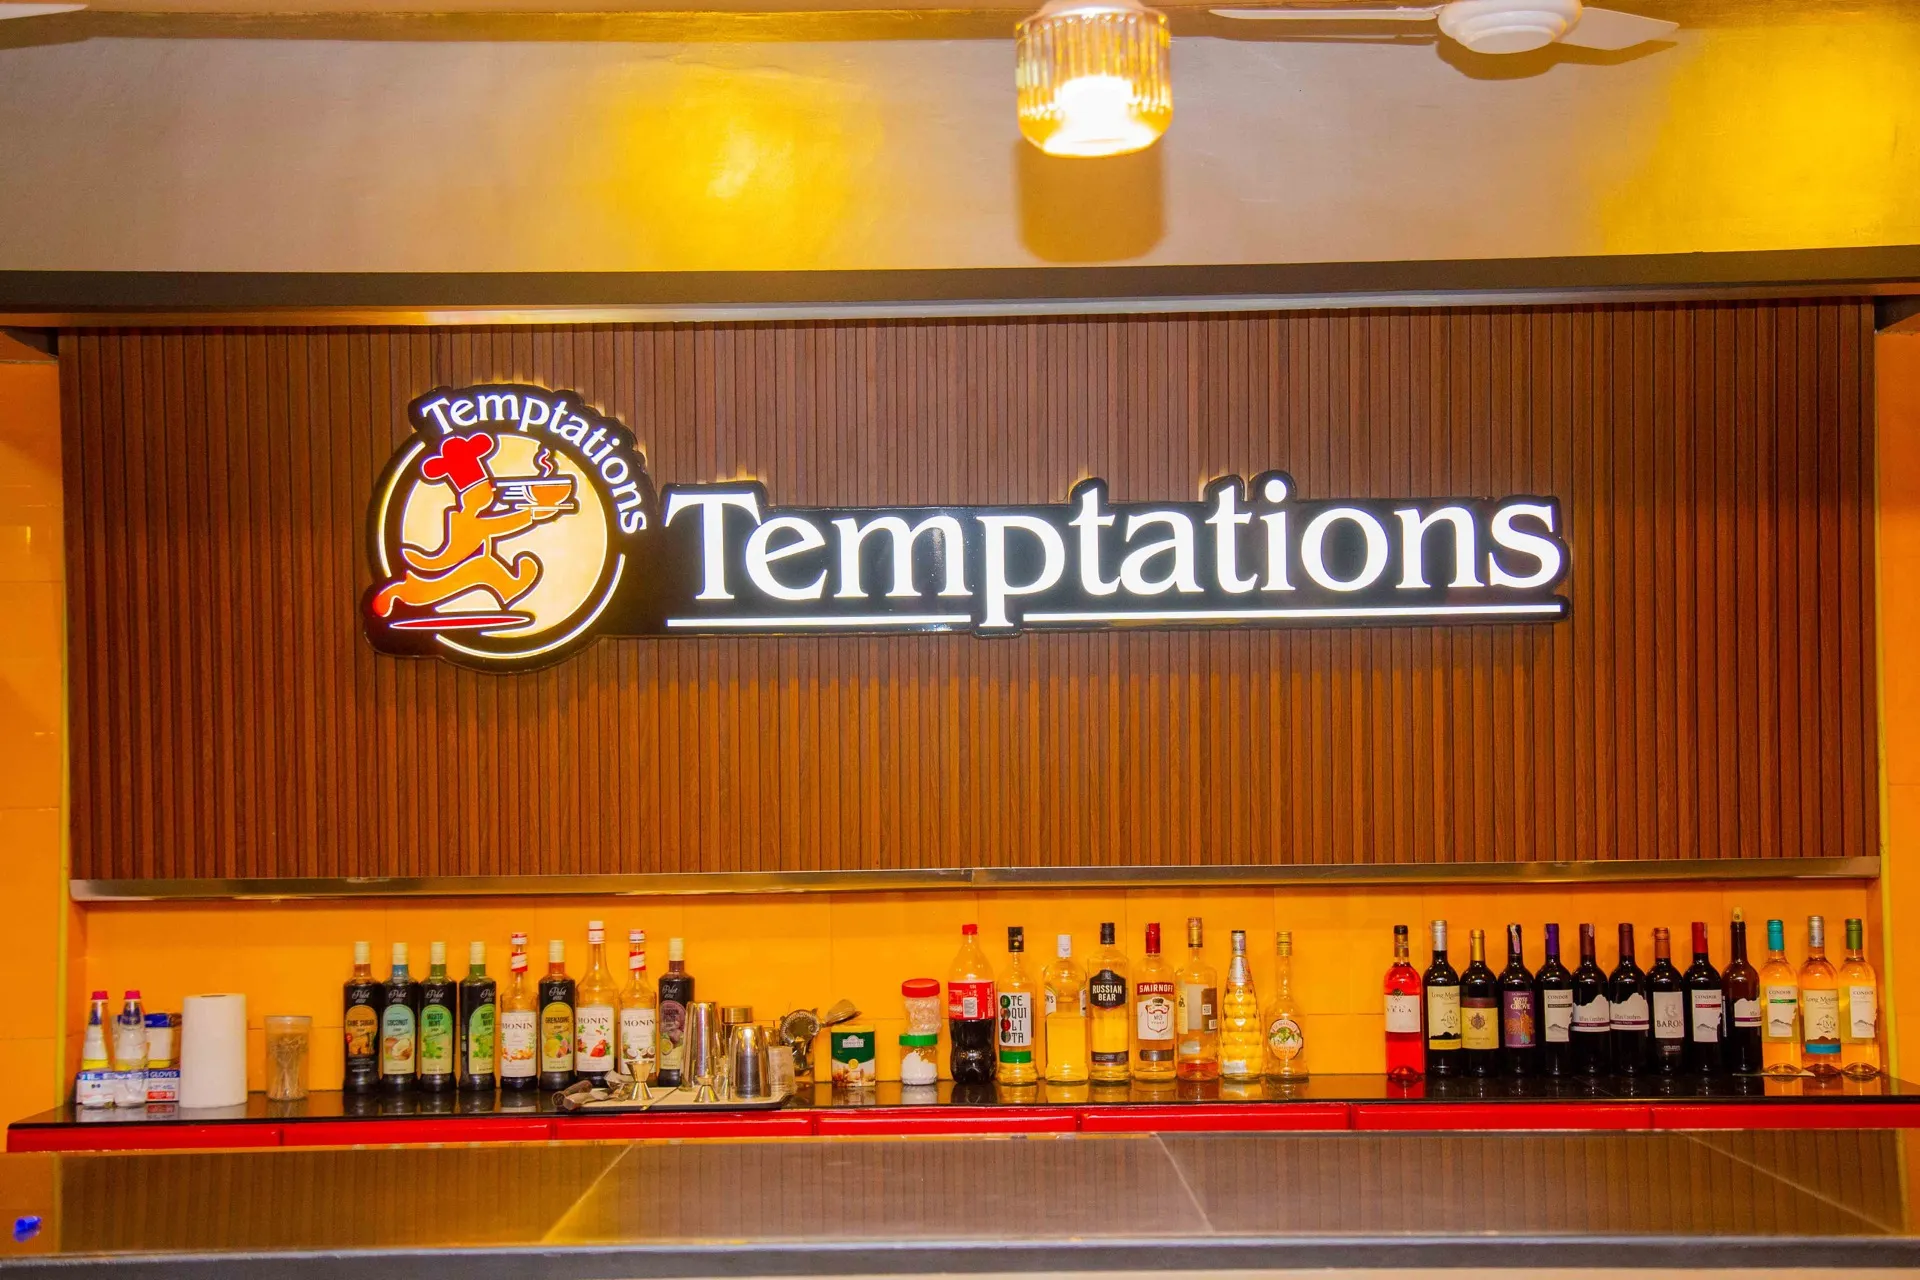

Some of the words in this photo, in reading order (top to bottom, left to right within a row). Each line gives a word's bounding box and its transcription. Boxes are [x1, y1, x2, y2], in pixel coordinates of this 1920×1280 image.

[422, 394, 646, 534] Temptations
[665, 479, 1562, 628] Temptations
[1092, 984, 1122, 994] RUSSIAN
[1139, 984, 1173, 993] SMIRNOFF
[1011, 995, 1023, 1007] TE
[1098, 993, 1116, 1002] BEAR
[1011, 1007, 1027, 1019] QUI
[578, 1017, 608, 1025] MONIN
[624, 1018, 655, 1027] MONIN
[1011, 1019, 1023, 1031] LI
[1011, 1032, 1024, 1044] TA
[150, 1070, 178, 1079] GLOVES
